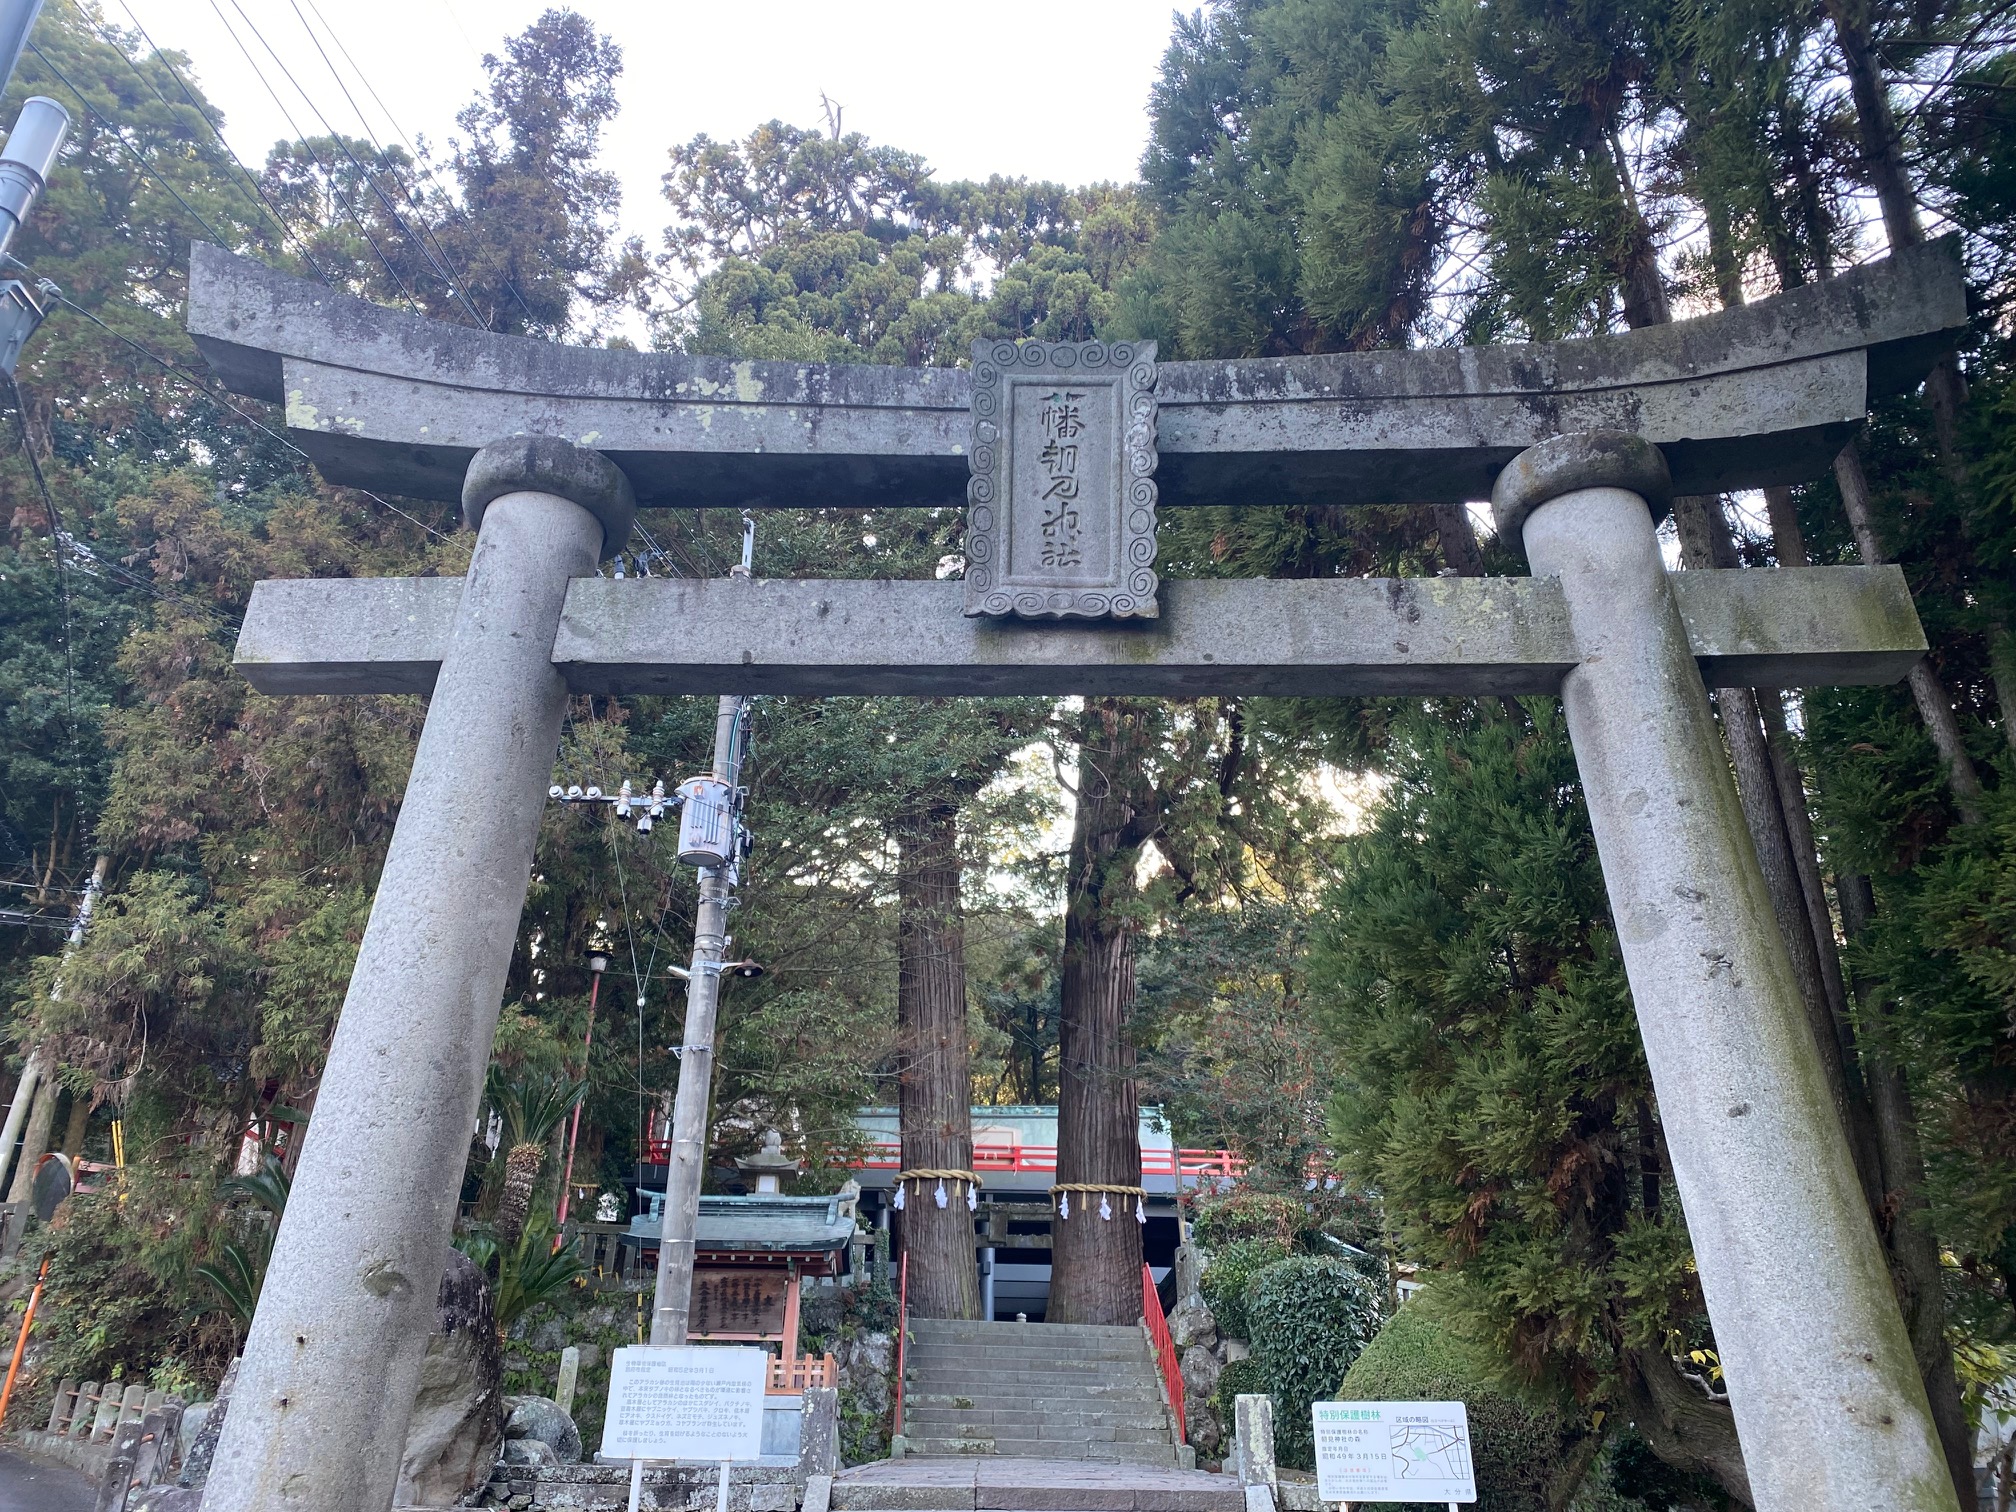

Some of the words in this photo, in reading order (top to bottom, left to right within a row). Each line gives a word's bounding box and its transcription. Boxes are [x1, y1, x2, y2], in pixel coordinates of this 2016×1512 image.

[1319, 1409, 1381, 1420] 特別保護樹林
